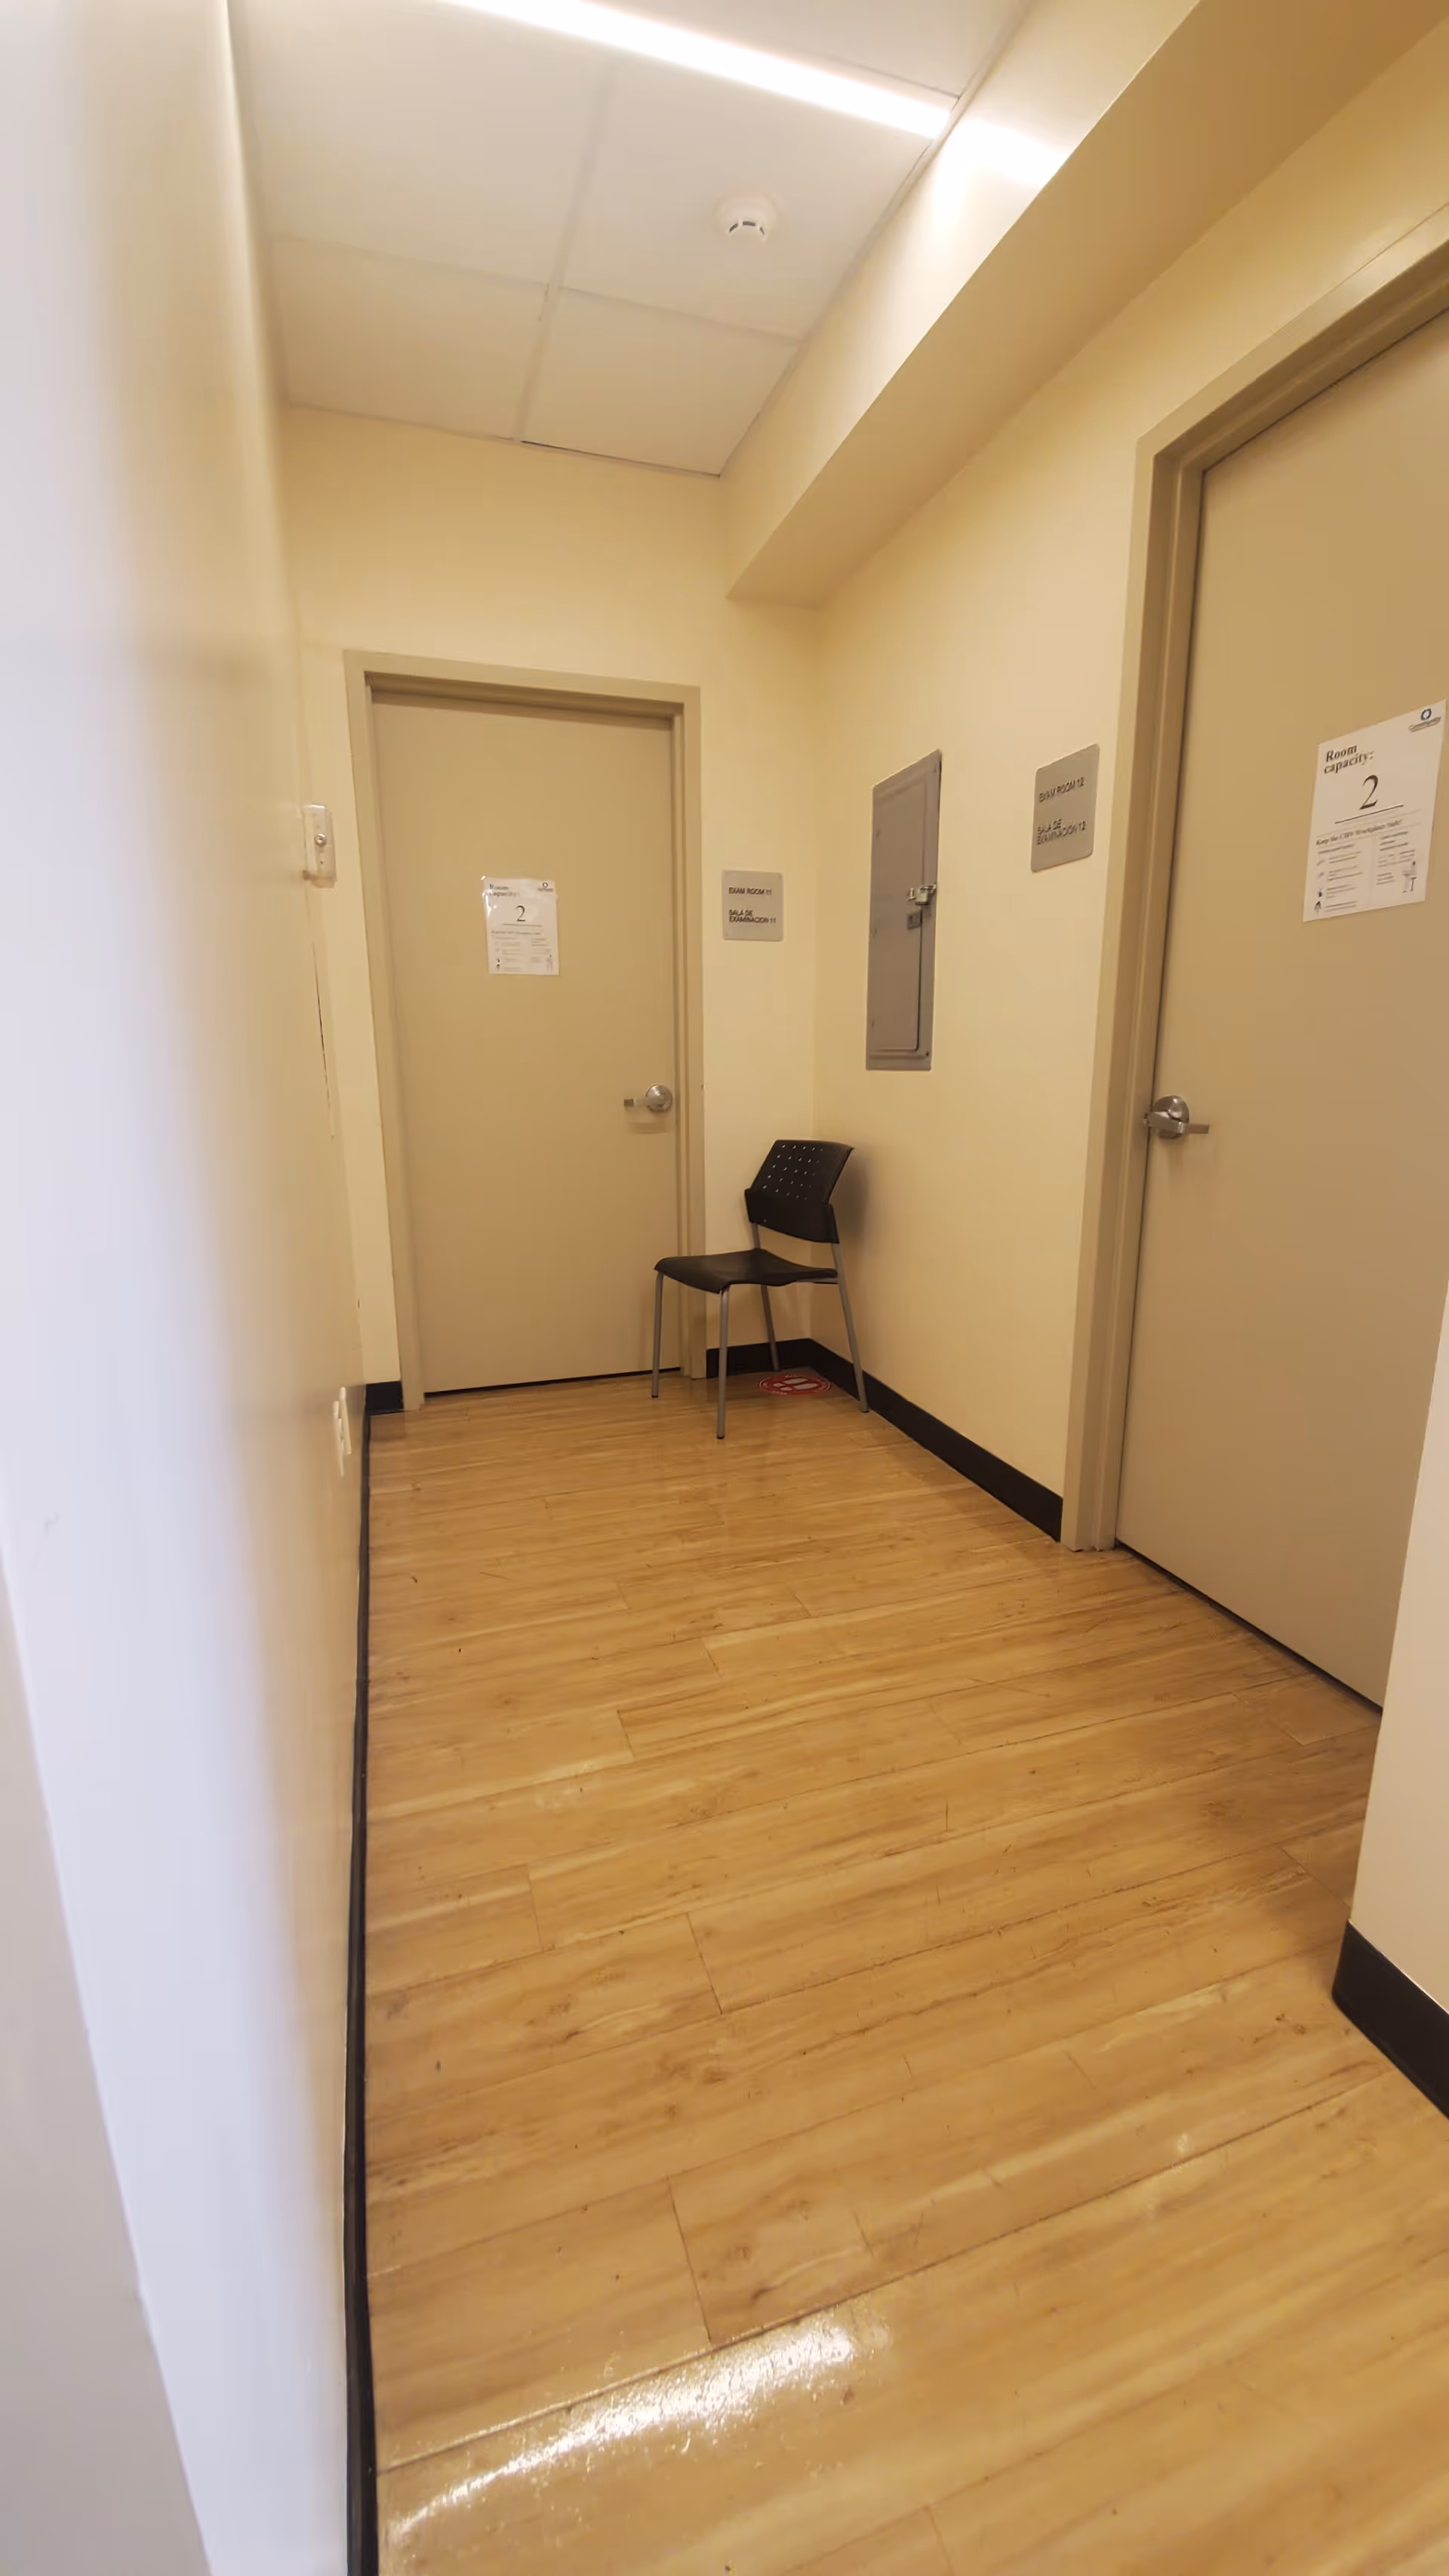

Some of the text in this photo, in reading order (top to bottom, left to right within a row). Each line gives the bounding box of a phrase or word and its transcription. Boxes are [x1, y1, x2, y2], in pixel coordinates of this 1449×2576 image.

[1324, 751, 1374, 774] capacity:
[1326, 745, 1358, 762] Room
[1359, 774, 1379, 810] 2
[515, 905, 526, 922] 2
